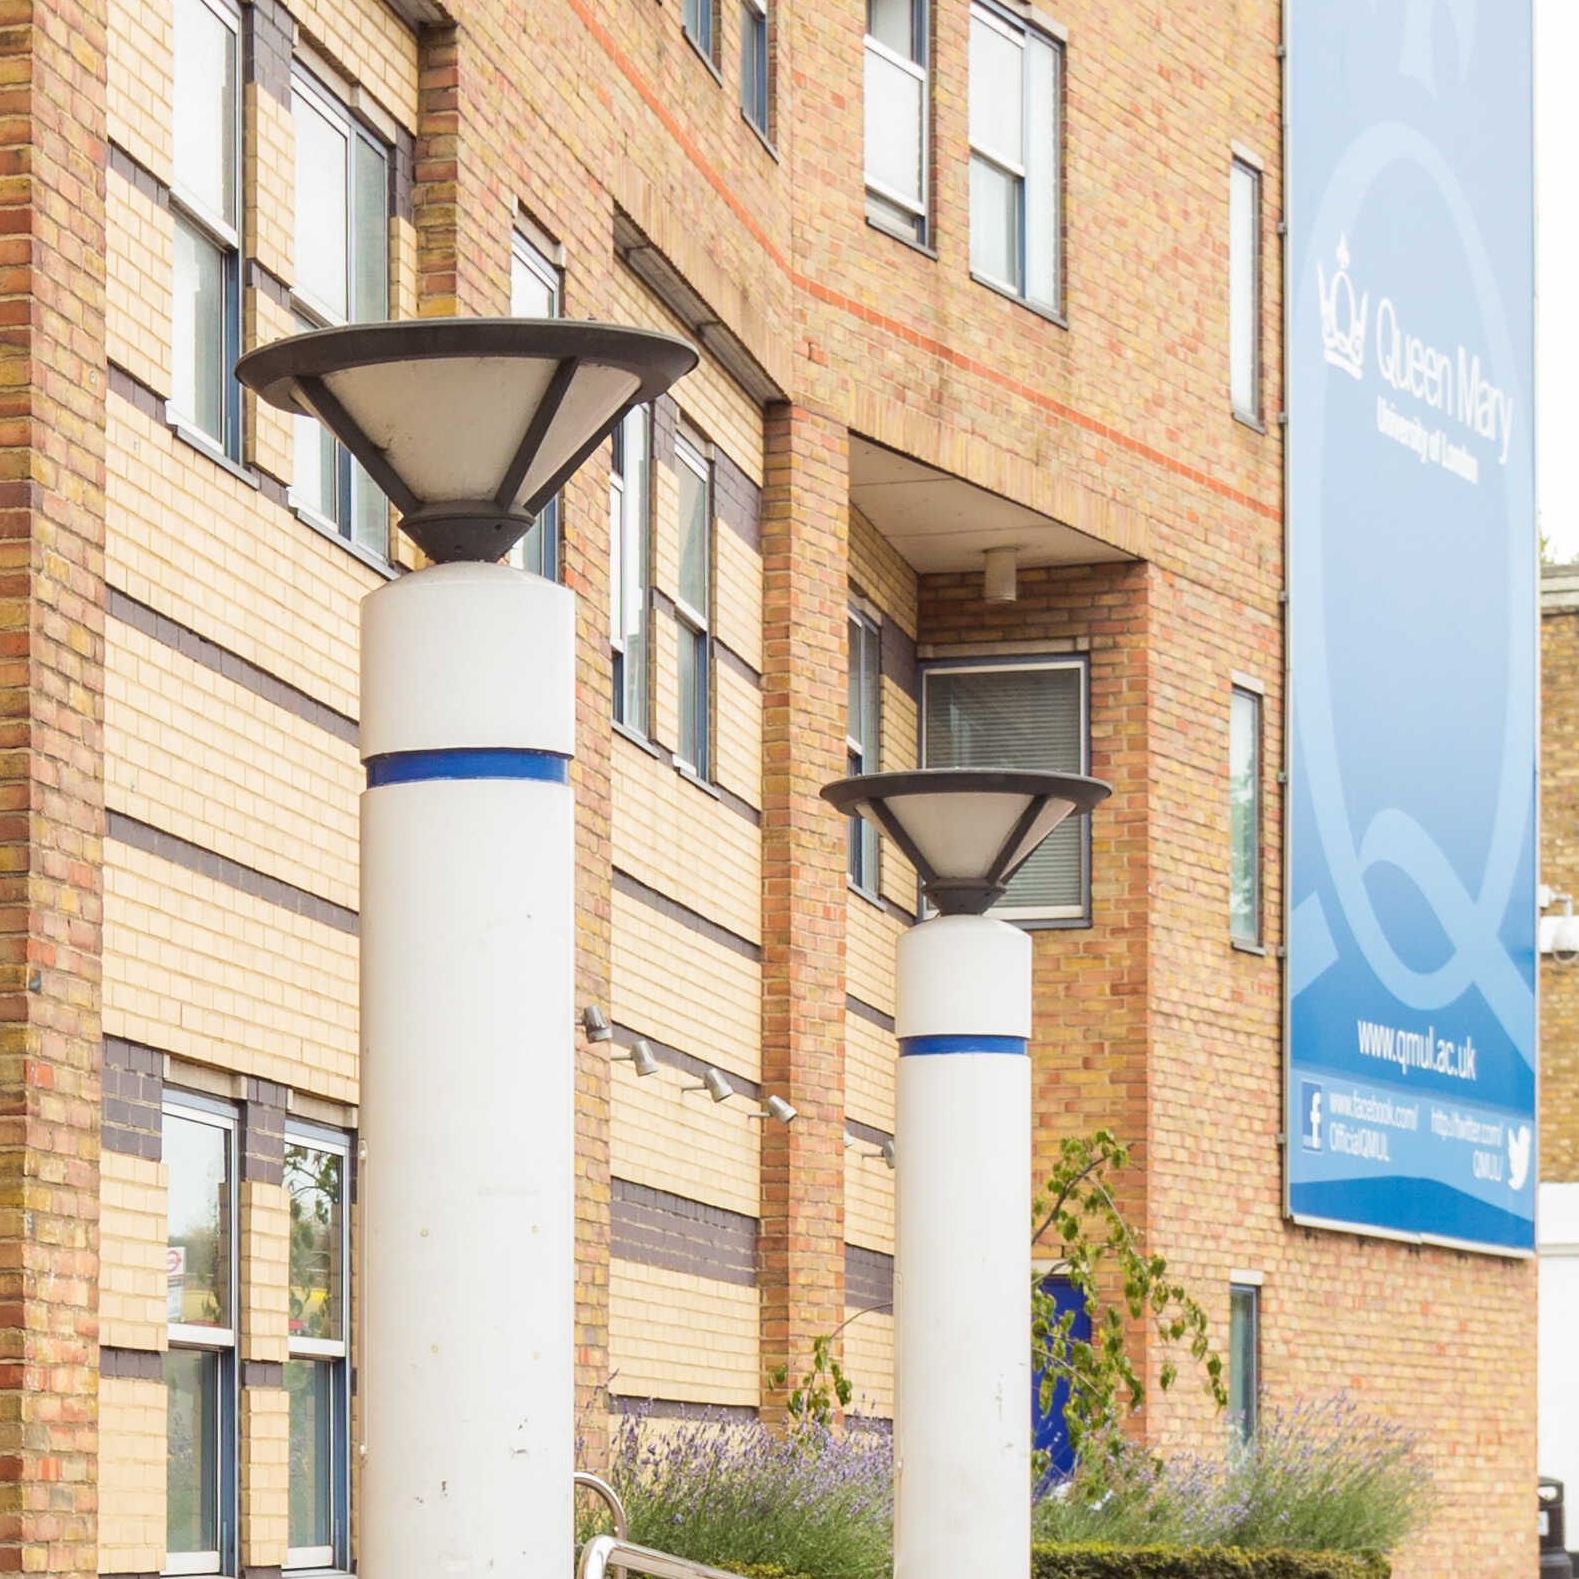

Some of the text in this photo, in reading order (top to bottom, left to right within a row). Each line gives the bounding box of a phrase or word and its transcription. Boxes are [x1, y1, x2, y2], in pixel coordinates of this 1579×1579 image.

[1376, 297, 1513, 465] Queen Mary
[1357, 1019, 1476, 1081] www.qmul.ac.uk
